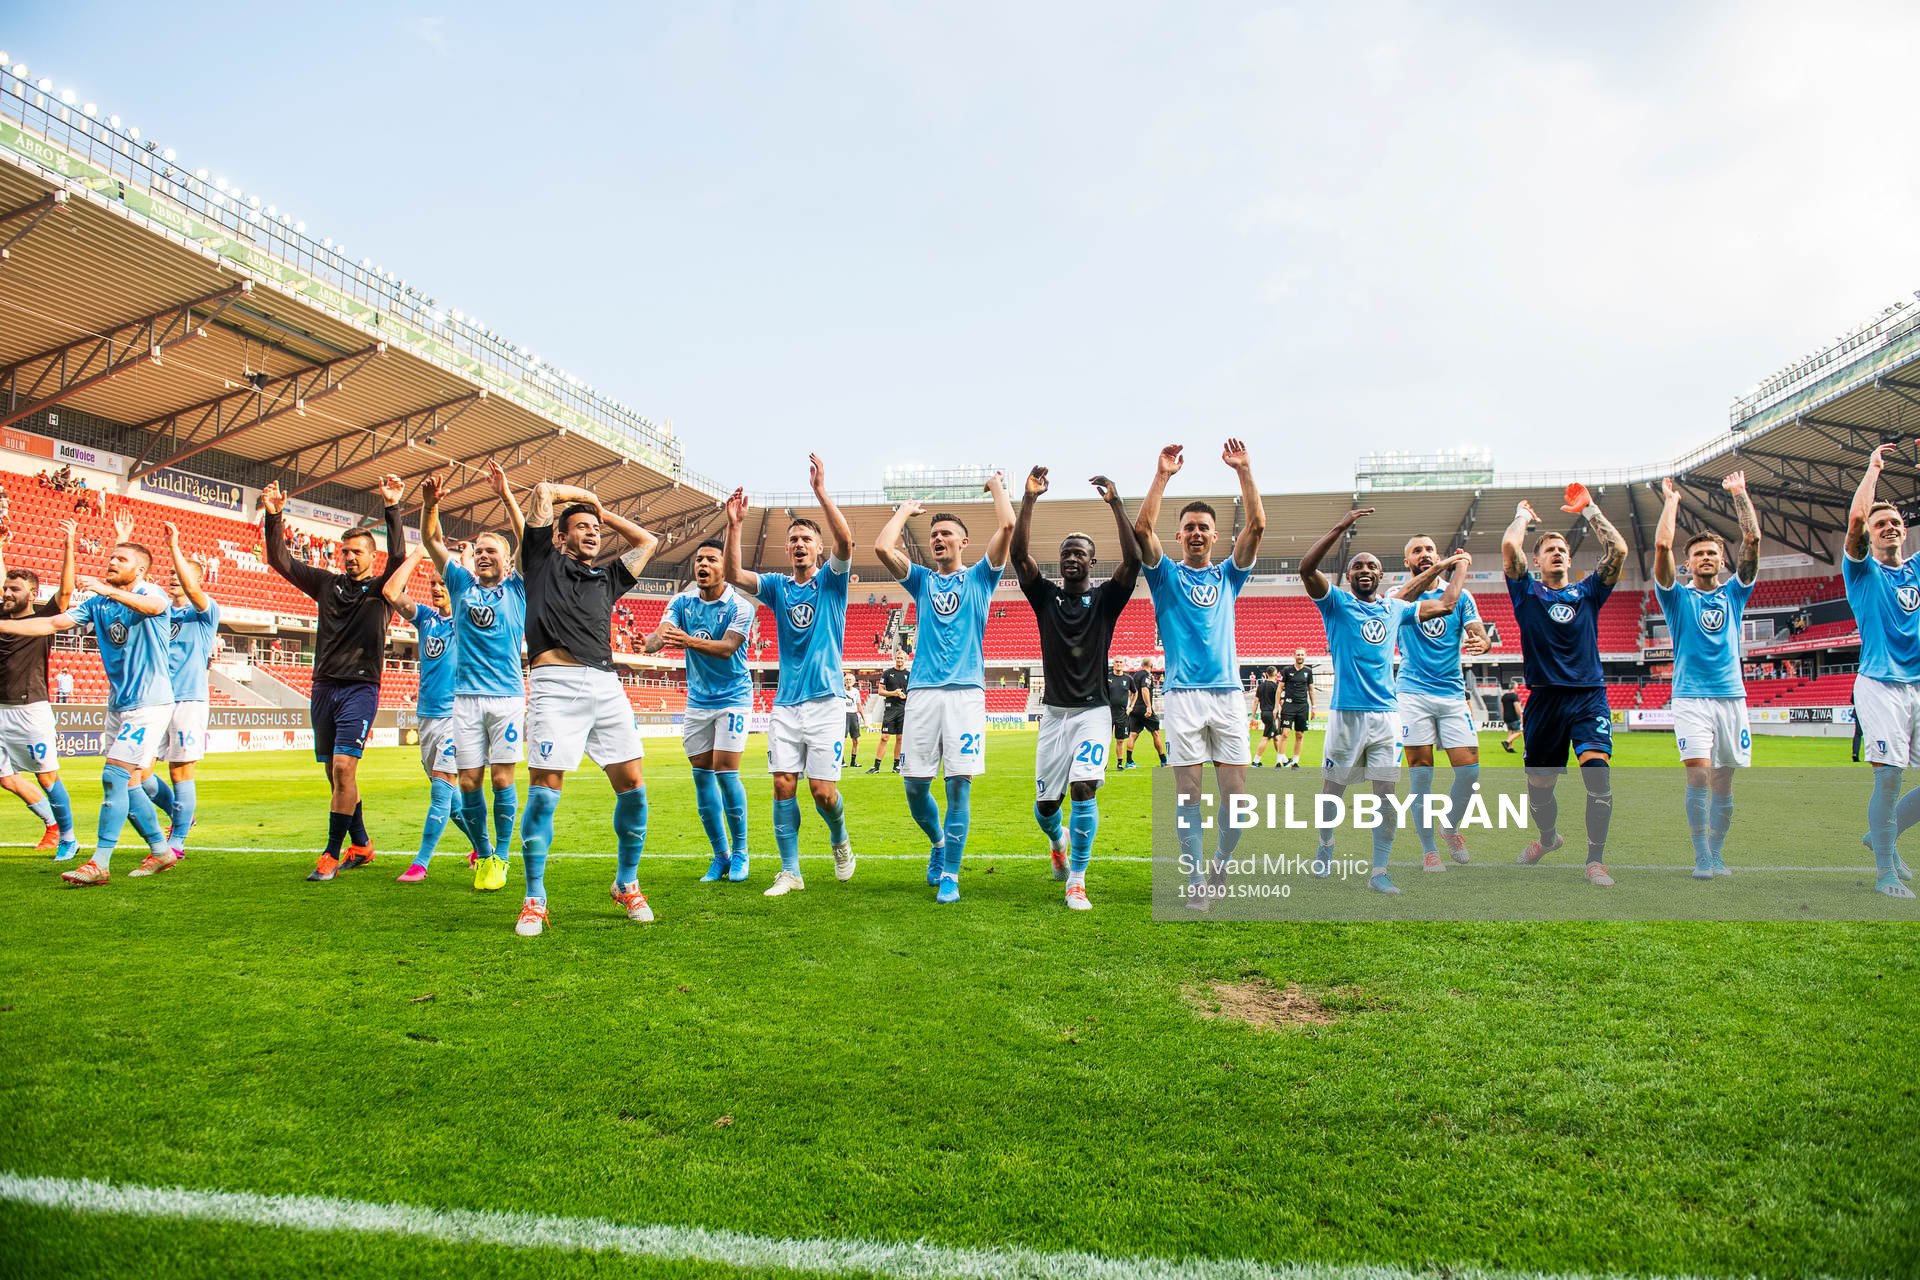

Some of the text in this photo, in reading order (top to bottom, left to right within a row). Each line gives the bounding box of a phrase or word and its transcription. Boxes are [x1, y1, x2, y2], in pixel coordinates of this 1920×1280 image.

[5, 438, 26, 451] HOLM
[60, 445, 96, 463] AddVoice
[144, 469, 230, 504] GuldFågeln
[209, 712, 303, 726] ALTEVADSHUS.SE
[728, 712, 745, 733] 18
[1790, 708, 1832, 720] ZIWA ZIWA
[117, 723, 146, 745] 24
[177, 730, 196, 748] 16
[504, 722, 518, 743] 6
[1740, 729, 1751, 749] 8
[26, 743, 47, 760] 19
[833, 741, 843, 762] 9
[1076, 741, 1104, 766] 20
